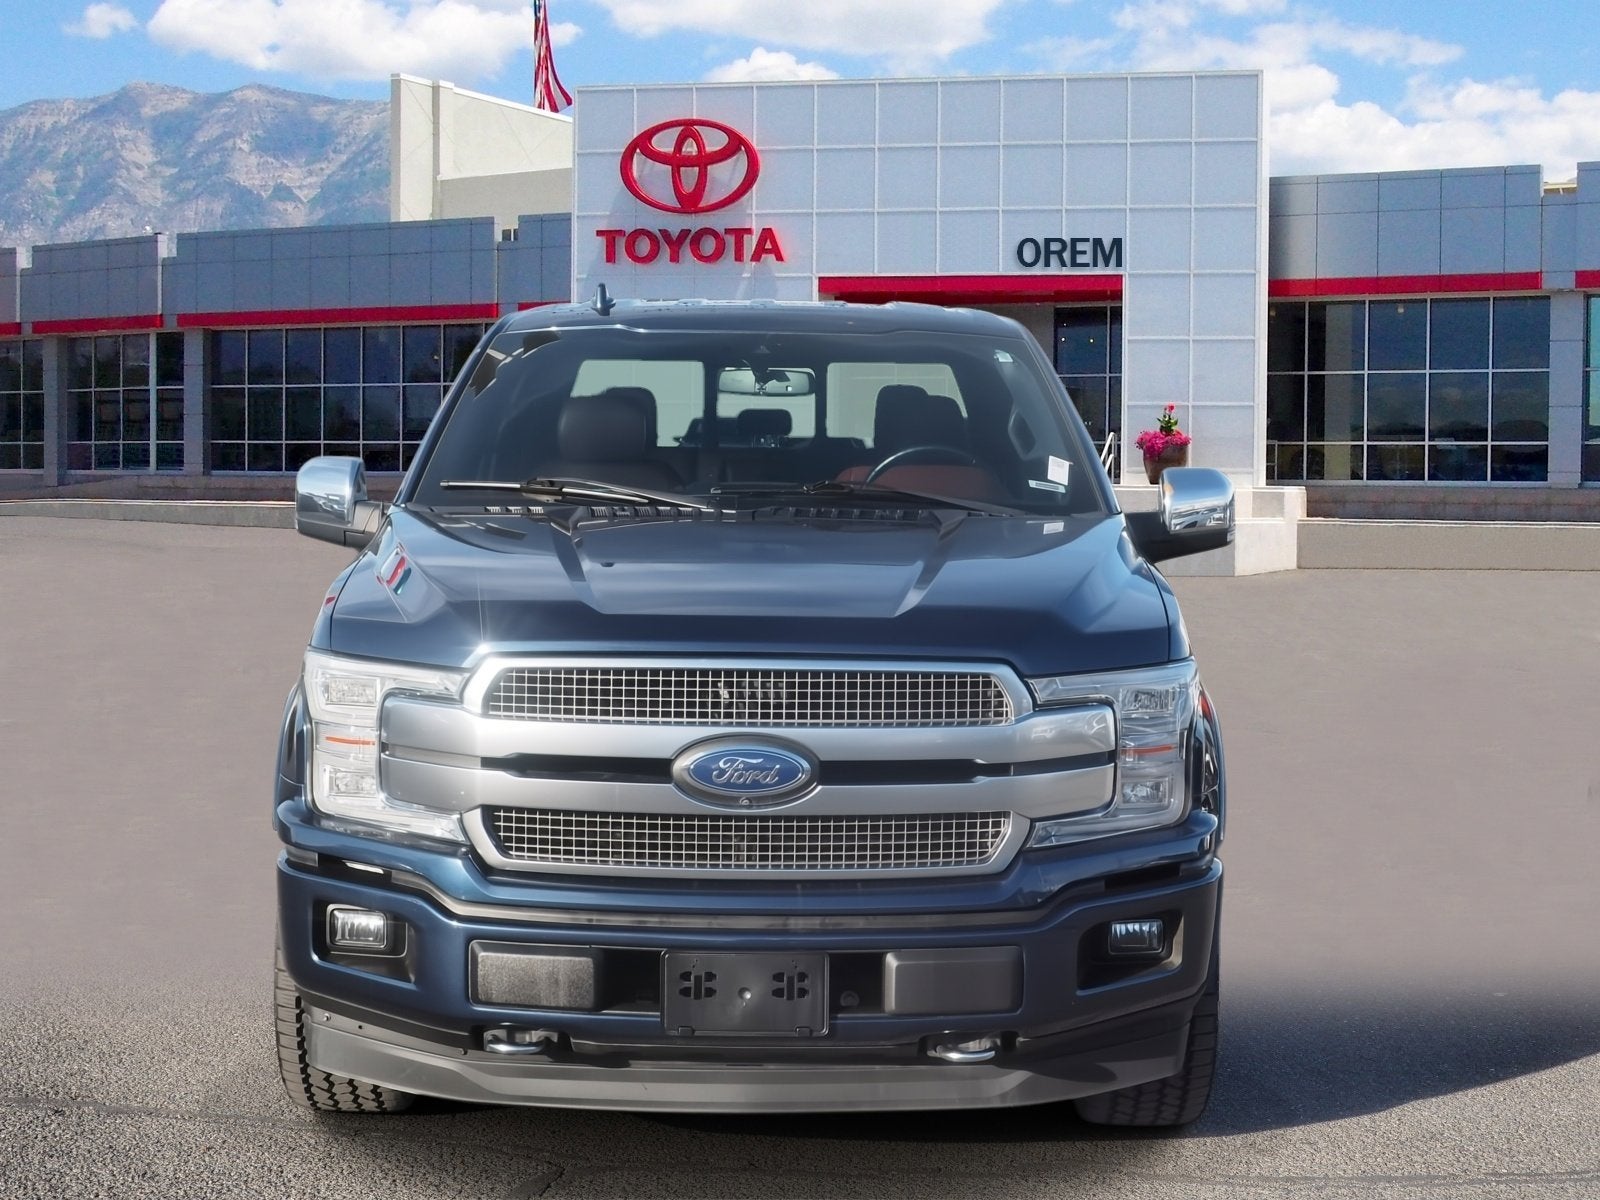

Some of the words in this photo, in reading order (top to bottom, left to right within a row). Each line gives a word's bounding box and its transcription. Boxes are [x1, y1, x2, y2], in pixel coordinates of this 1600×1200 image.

[596, 227, 784, 264] TOYOTA
[1017, 238, 1123, 267] OREM
[712, 756, 780, 784] Ford
